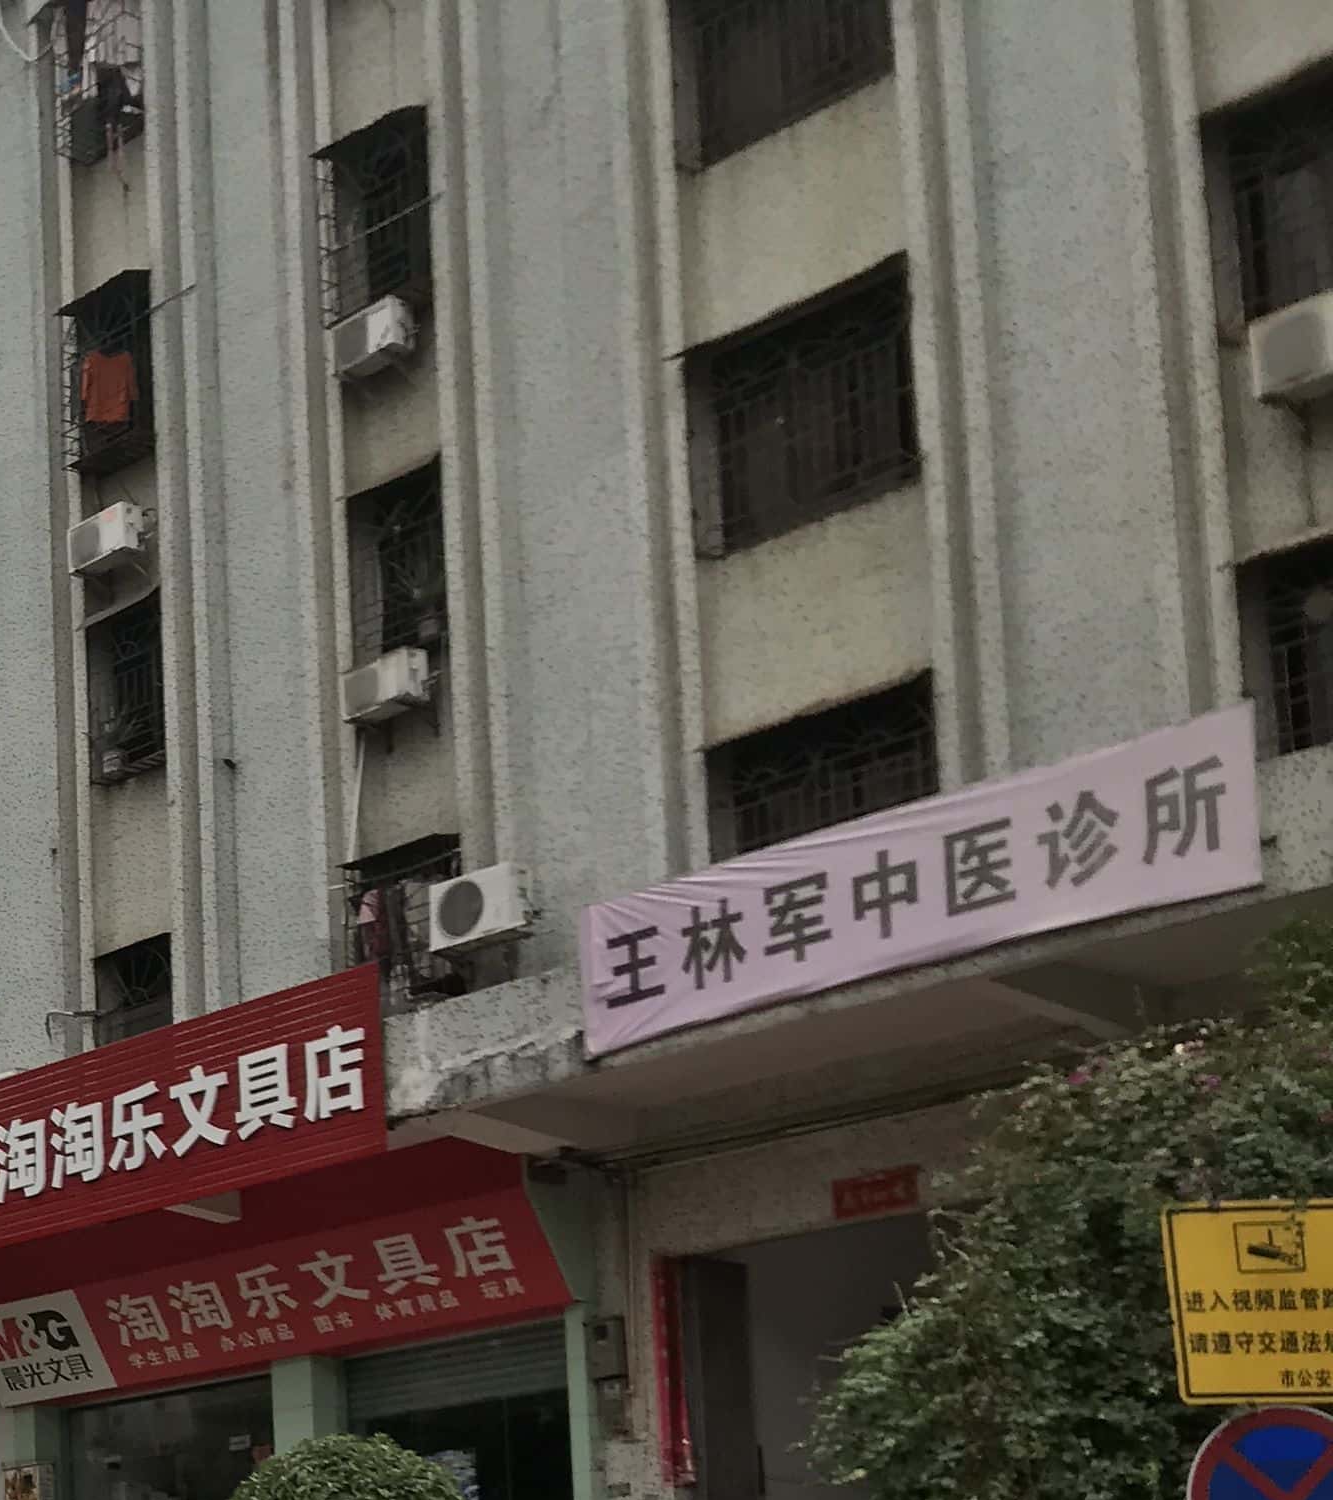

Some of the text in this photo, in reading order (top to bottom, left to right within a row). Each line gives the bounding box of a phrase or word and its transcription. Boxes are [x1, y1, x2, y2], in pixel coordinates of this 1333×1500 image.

[606, 755, 1229, 1009] 王林军中医诊所
[105, 1215, 516, 1348] 淘淘乐文具店
[127, 1341, 201, 1370] 学生用品
[220, 1323, 295, 1353] 办公用品
[375, 1288, 460, 1322] 体育用品
[479, 1277, 525, 1300] 玩具
[1, 1353, 93, 1391] 晨光文具
[1280, 1368, 1332, 1388] 市公安
